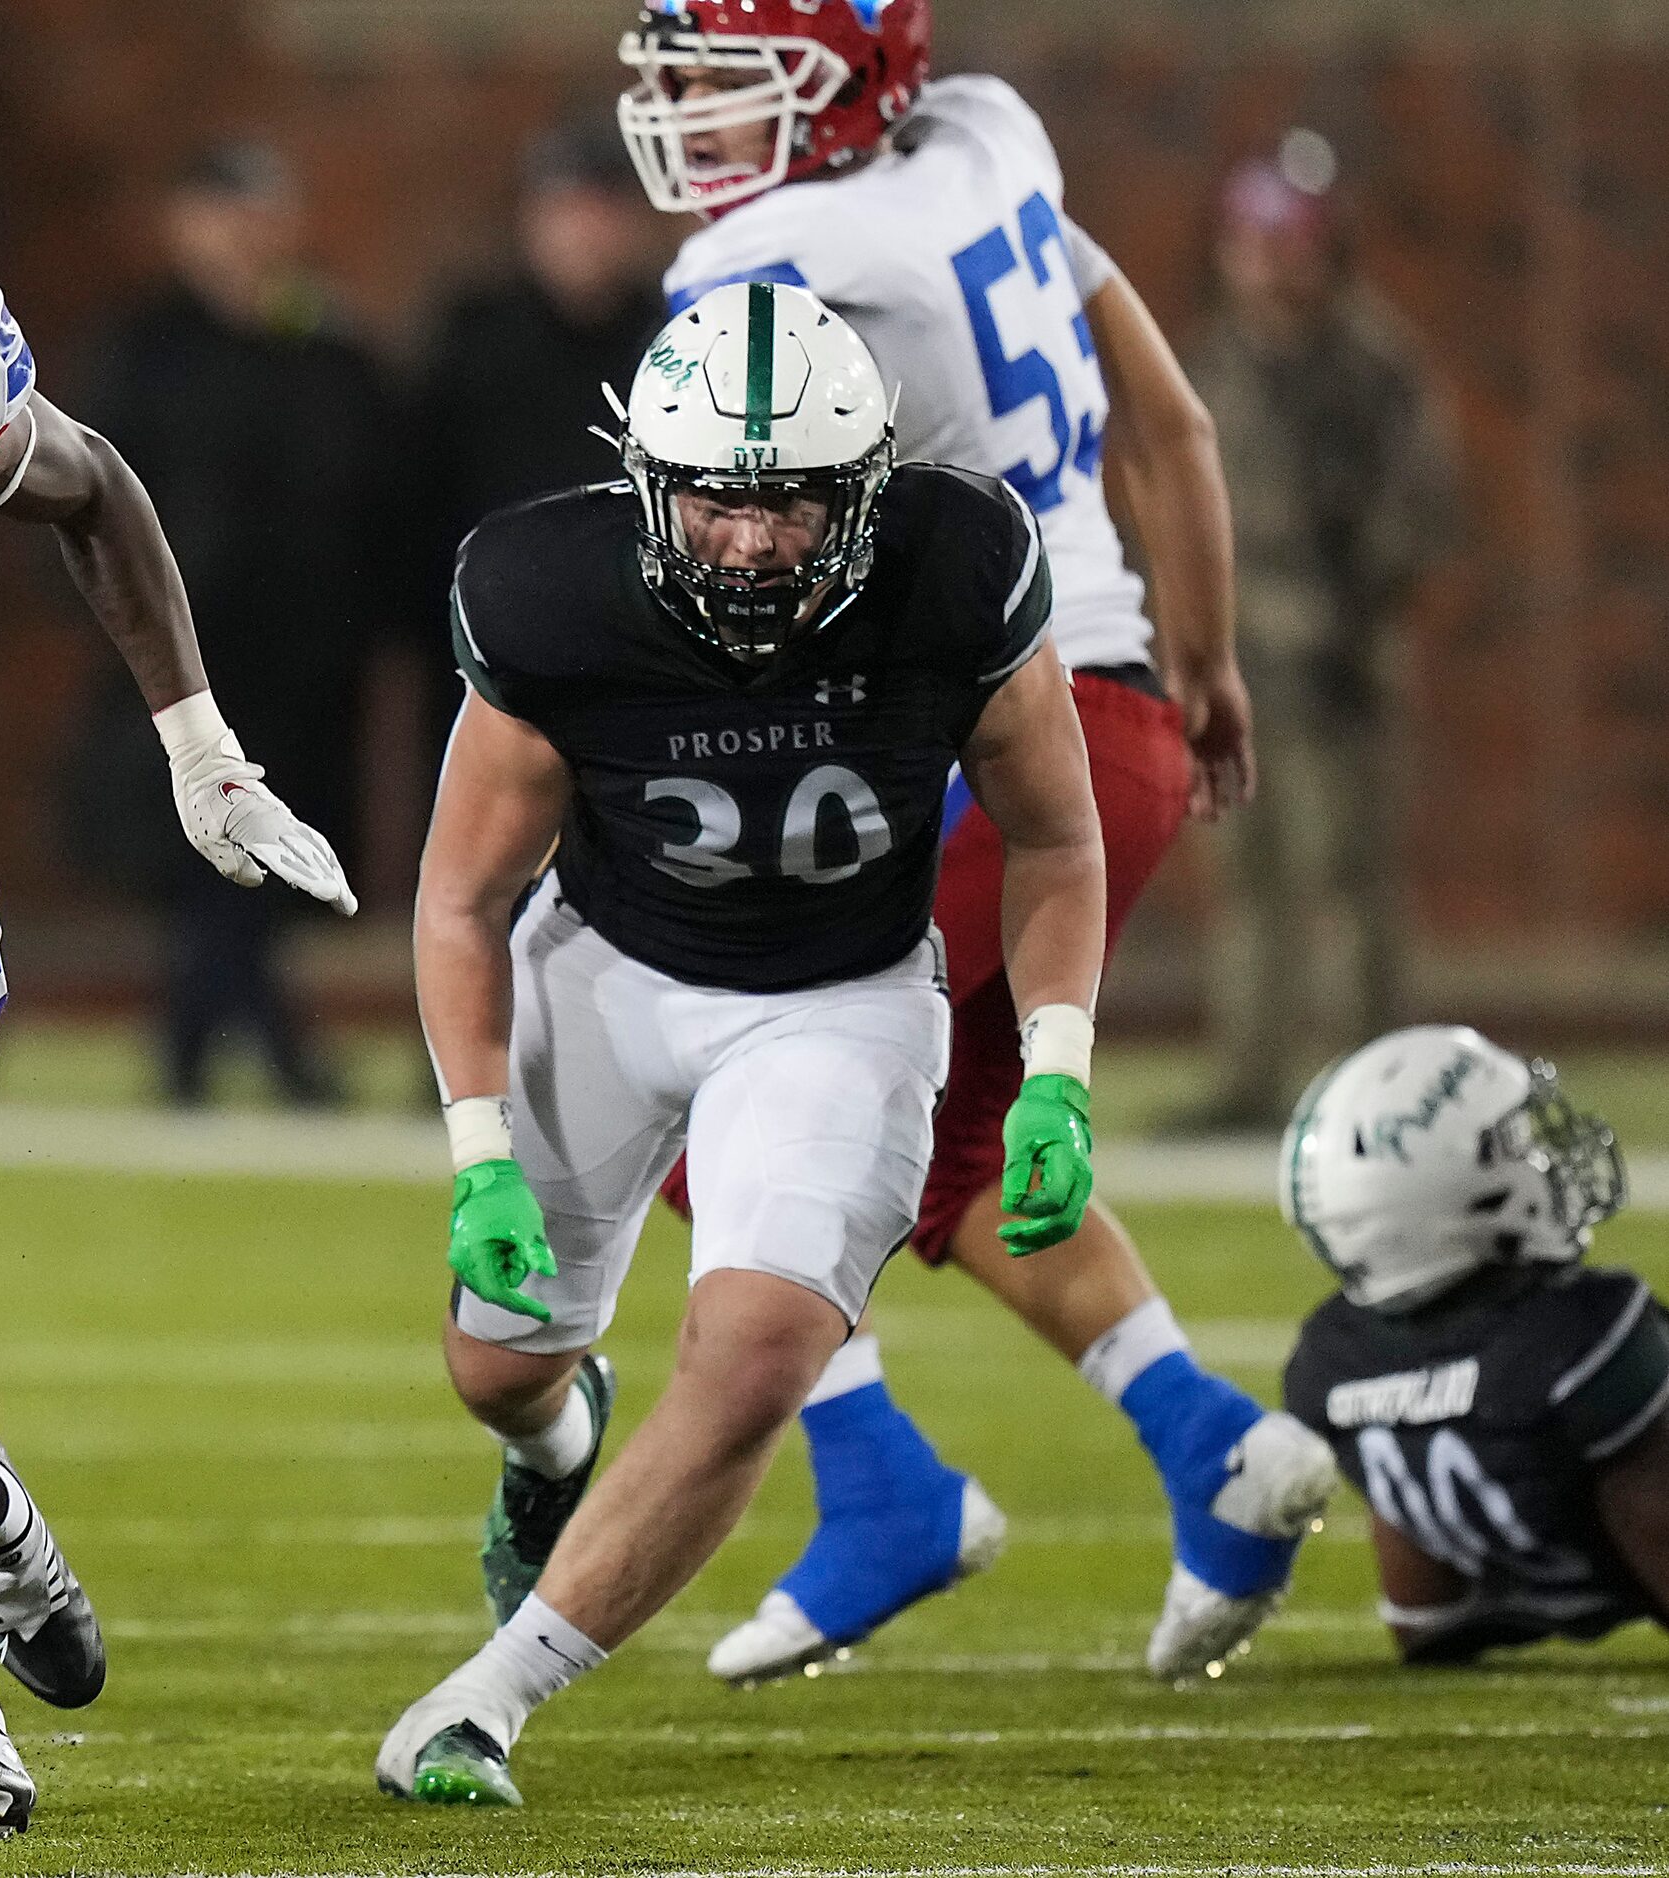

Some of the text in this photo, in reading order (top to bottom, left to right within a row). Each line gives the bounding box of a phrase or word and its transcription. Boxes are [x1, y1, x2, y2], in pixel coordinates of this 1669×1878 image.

[733, 447, 778, 471] DYJ
[667, 720, 835, 761] PROSPER
[643, 763, 894, 889] 30
